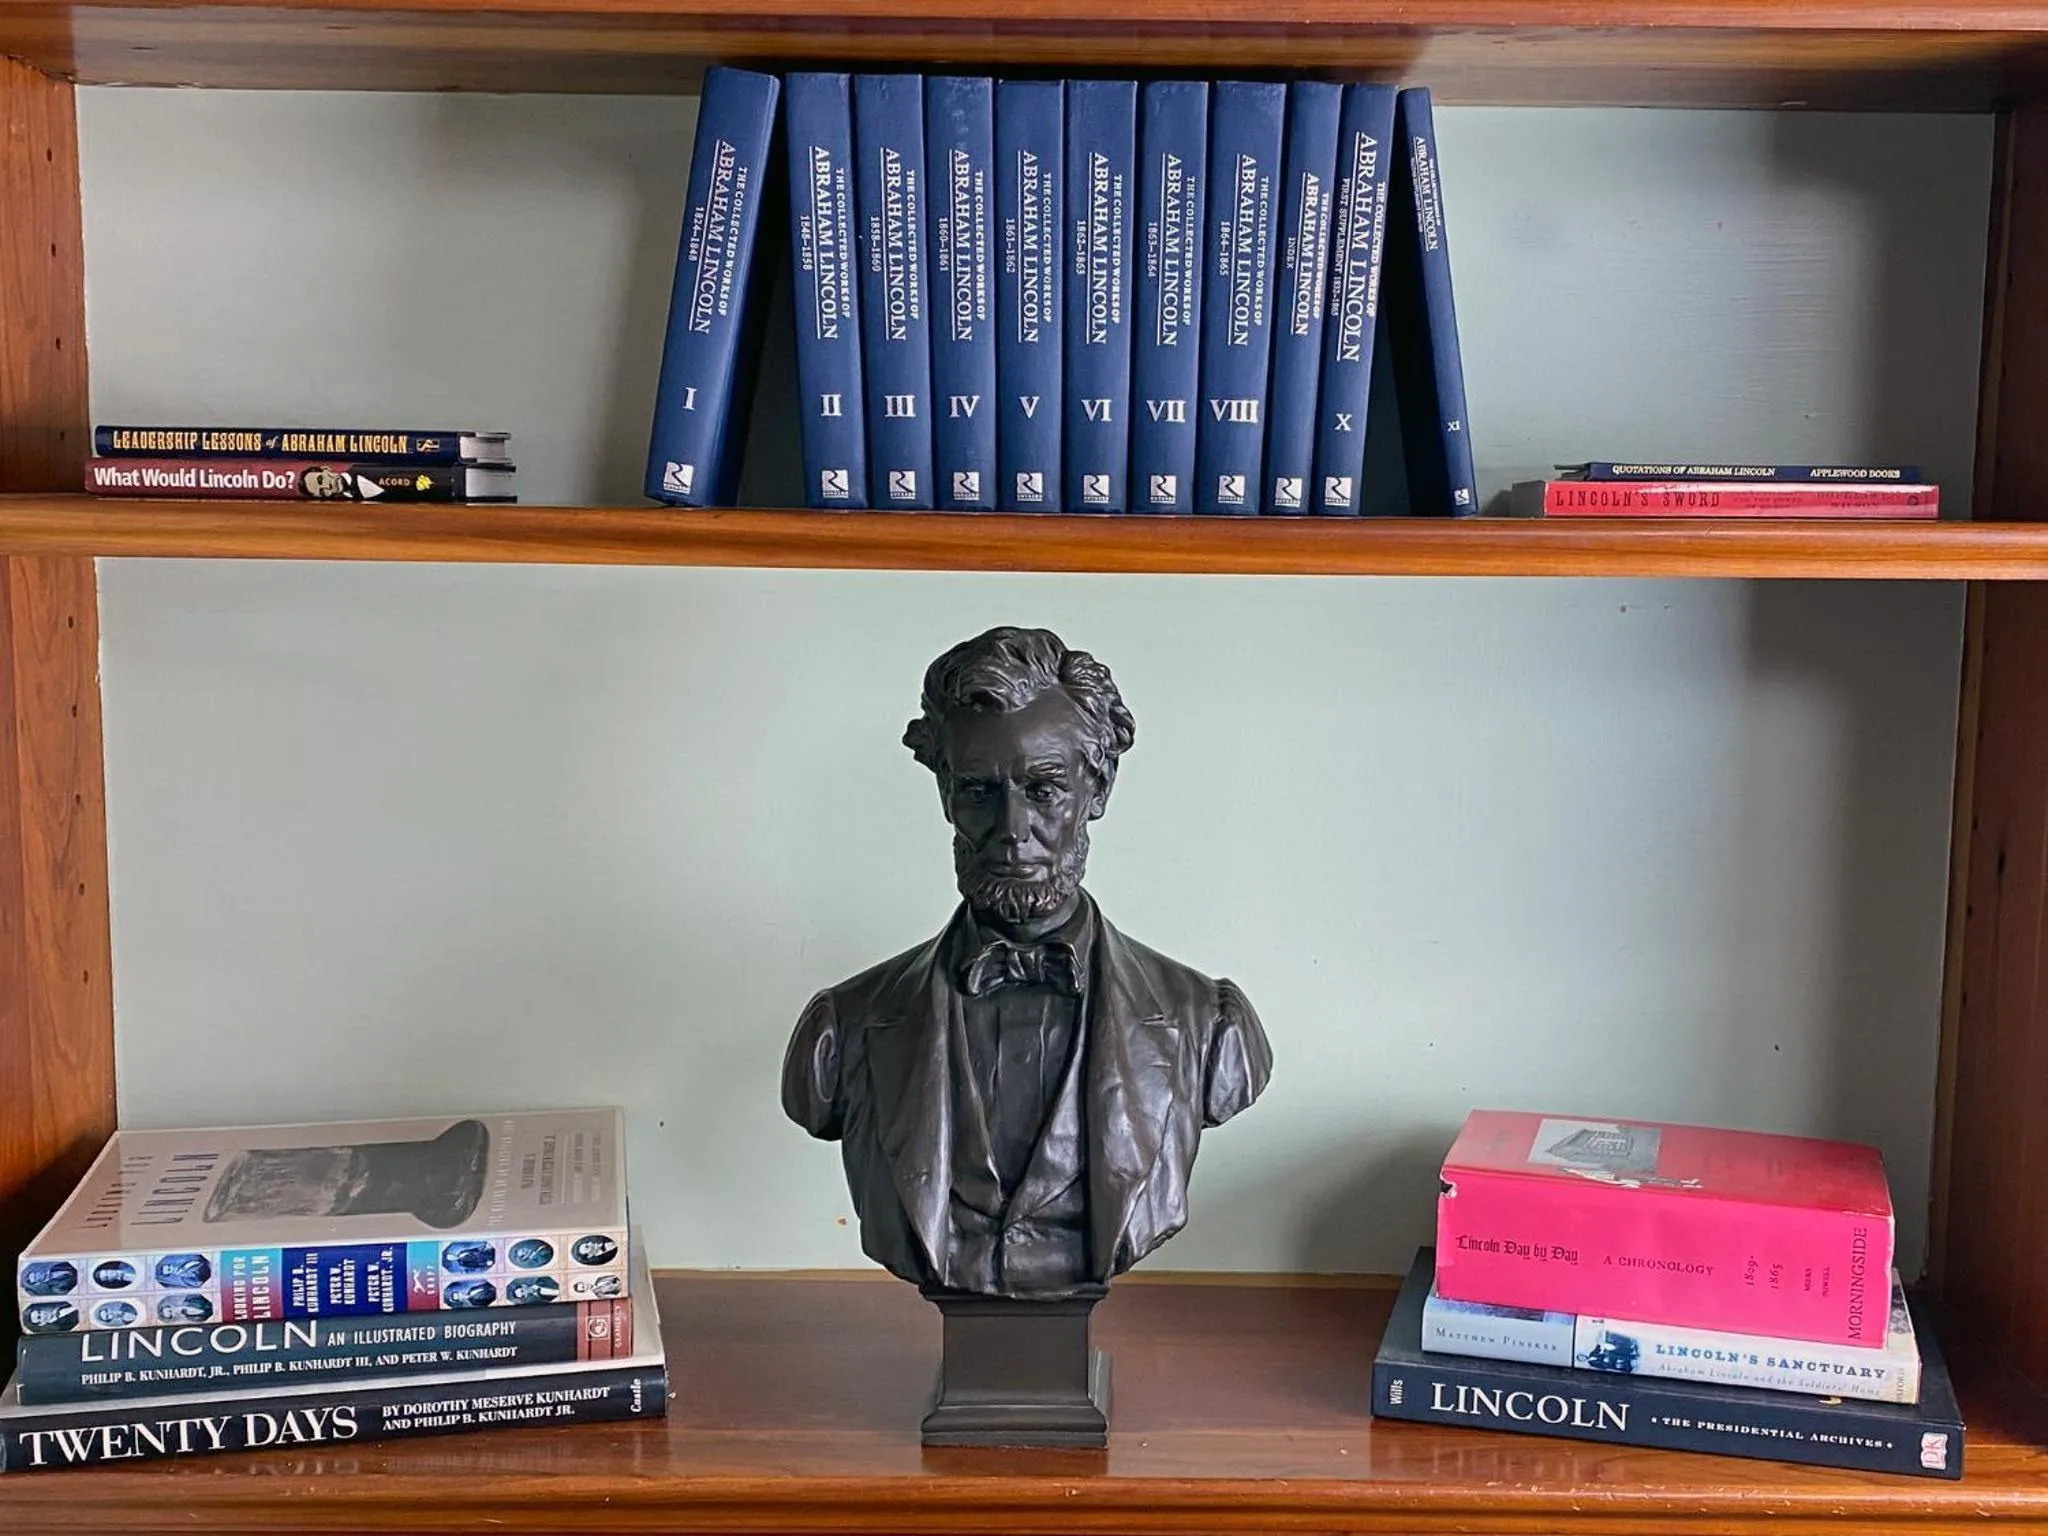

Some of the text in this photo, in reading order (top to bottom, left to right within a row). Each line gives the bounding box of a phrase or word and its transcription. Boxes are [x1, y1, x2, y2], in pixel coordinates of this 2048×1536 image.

[1416, 136, 1432, 195] ABRAHAM
[1424, 199, 1438, 250] LINCOLN
[694, 141, 736, 334] ABRAHAM LINCOLN
[718, 167, 748, 317] THE COLLECTED WORKS OF
[814, 146, 838, 340] ABRAHAM LINCOLN
[836, 168, 850, 318] THE COLLECTED WORKS OF
[886, 148, 906, 341] ABRAHAM LINCOLN
[906, 170, 920, 320] THE COLLECTED WORKS OF
[955, 150, 972, 341] ABRAHAM LINCOLN
[974, 170, 985, 321] THE COLLECTED WORKS OF
[1023, 150, 1038, 343] ABRAHAM LINCOLN
[1042, 172, 1052, 323] THE COLLECTED WORKS OF
[1092, 152, 1109, 344] ABRAHAM LINCOLN
[1111, 174, 1122, 324] THE COLLECTED WORKS OF
[1163, 154, 1182, 346] ABRAHAM LINCOLN
[1182, 176, 1196, 326] THE COLLECTED WORKS OF
[1234, 154, 1257, 346] ABRAHAM LINCOLN
[1254, 176, 1270, 326] THE COLLECTED WORKS OF
[1286, 237, 1296, 269] INDEX
[1295, 172, 1320, 336] ABRAHAM LINCOLN
[1342, 132, 1378, 362] ABRAHAM LINCOLN
[682, 388, 697, 410] I
[820, 394, 842, 416] II
[884, 394, 916, 417] III
[950, 395, 980, 417] IV
[1020, 396, 1040, 418] V
[1081, 399, 1112, 422] VI
[1146, 400, 1186, 422] VII
[1209, 400, 1259, 424] VIII
[113, 430, 408, 454] LEADERSHIP LESSONS of ABRAHAM LINCOLN
[1334, 413, 1352, 431] X
[93, 466, 296, 489] What Would Lincoln Do?
[378, 478, 410, 486] ACORD
[1612, 465, 1775, 476] QUOTATIONS OF ABRAHAM LINCOLN
[1810, 469, 1867, 478] APPLEWOOD
[1556, 490, 1720, 508] LINCOLN'S SWORD
[1456, 1234, 1578, 1265] Lincoln Day by Day
[1603, 1255, 1715, 1275] A CHRONOLOGY
[233, 1256, 248, 1320] LOOKING FOR
[252, 1255, 271, 1318] LINCOLN
[1769, 1263, 1784, 1289] 1865
[1848, 1227, 1867, 1340] MORNINGSIDE
[81, 1320, 517, 1362] LINCOLN AN ILLUSTRATED BIOGRAPHY
[81, 1372, 123, 1385] PHILIP
[125, 1371, 136, 1382] B.
[139, 1367, 206, 1381] KUNHARDT,
[233, 1362, 272, 1374] PHILIP
[275, 1361, 286, 1372] B.
[289, 1357, 353, 1372] KUNHARDT
[375, 1354, 400, 1366] AND
[402, 1352, 438, 1364] PETER
[442, 1351, 453, 1361] W.
[456, 1346, 518, 1360] KUNHARDT
[1656, 1344, 1887, 1379] LINCOLN'S SANCTUARY
[382, 1387, 611, 1418] BY DOROTHY MESERVE KUNHARDT
[1390, 1380, 1404, 1405] Wills
[1430, 1382, 1631, 1431] LINCOLN
[19, 1405, 359, 1466] TWENTY DAYS
[382, 1405, 575, 1431] AND PHILIP B. KUNHARDT JR.
[1662, 1417, 1883, 1448] THE PRESIDENTIAL ARCHIVES
